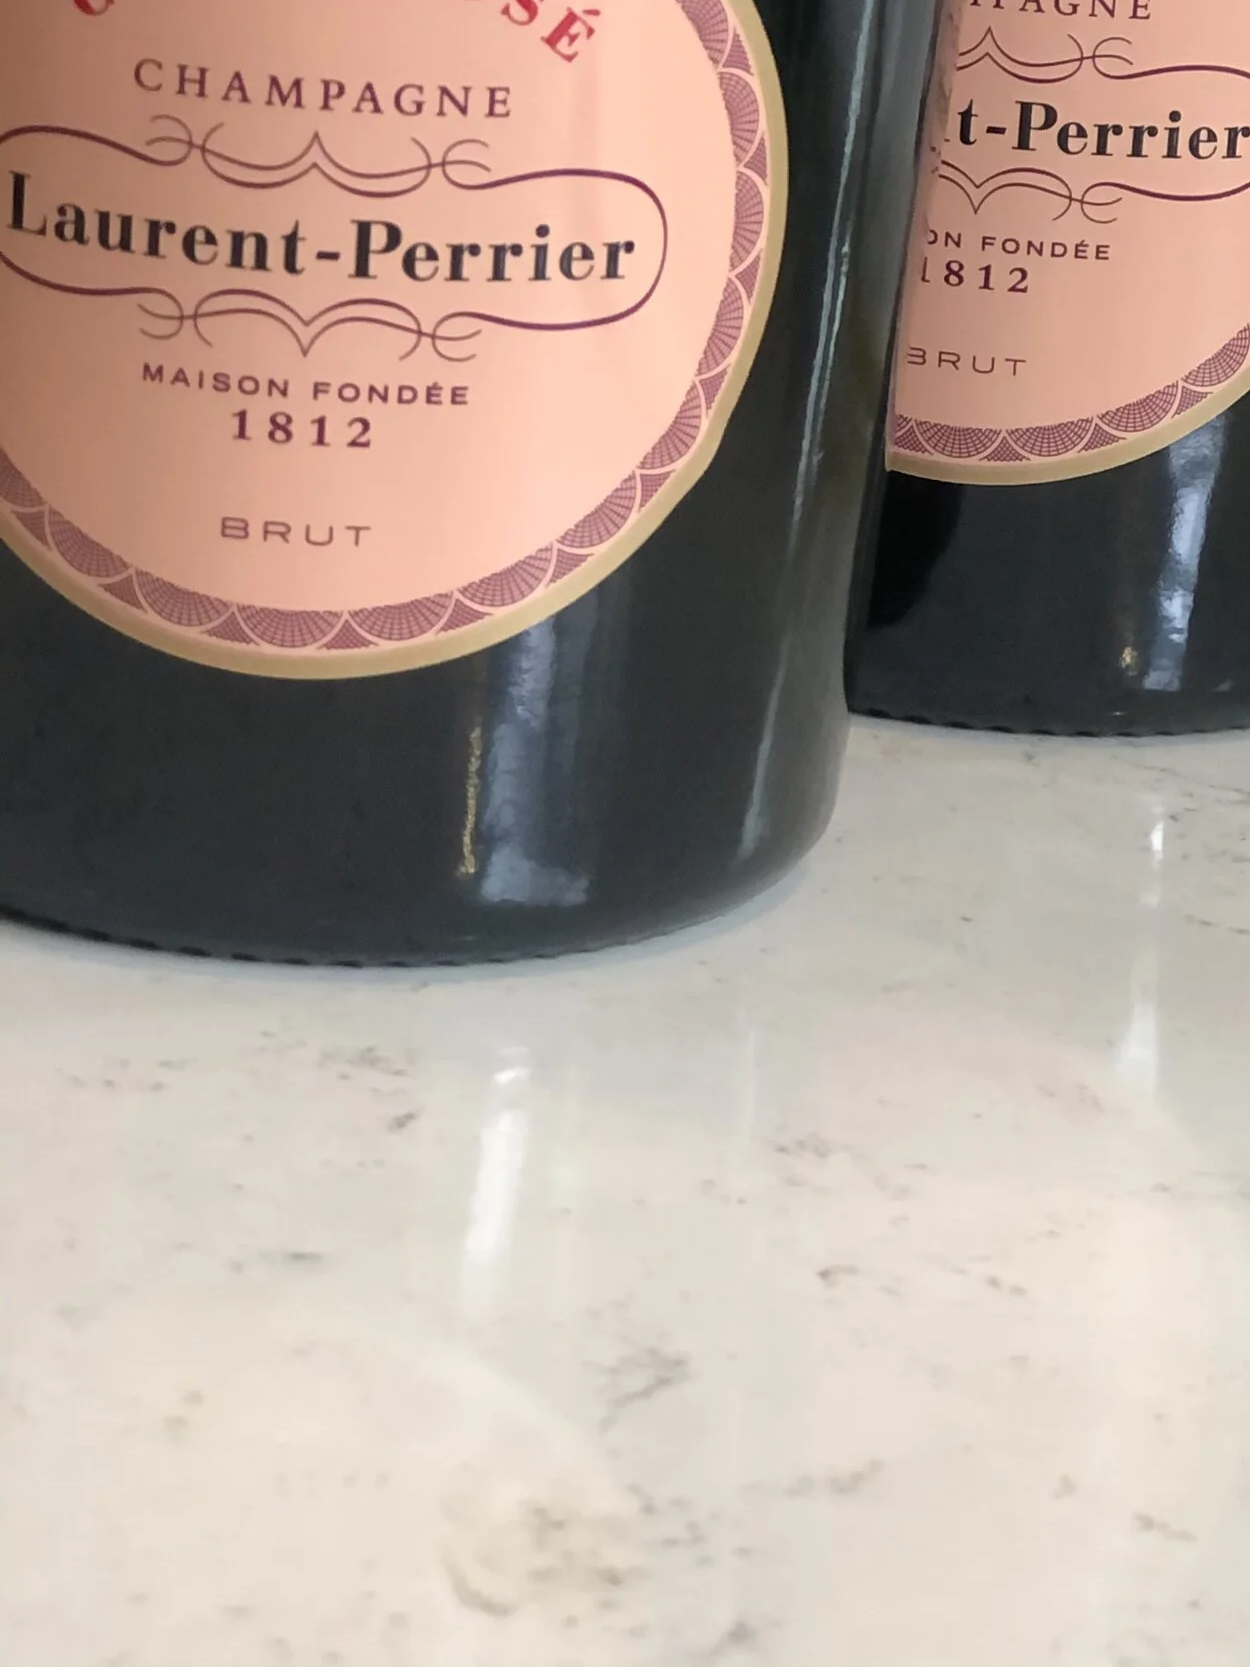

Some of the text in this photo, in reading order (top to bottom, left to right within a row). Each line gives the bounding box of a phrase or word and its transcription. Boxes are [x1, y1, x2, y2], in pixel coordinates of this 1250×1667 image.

[134, 58, 513, 118] CHAMPAGNE
[5, 171, 636, 283] Laurent-Perrier
[981, 235, 1112, 262] FONDÉE
[906, 346, 1027, 377] BRUT
[142, 362, 470, 406] MAISON FONDÉE
[231, 409, 372, 449] 1812
[220, 516, 372, 547] BRUT
